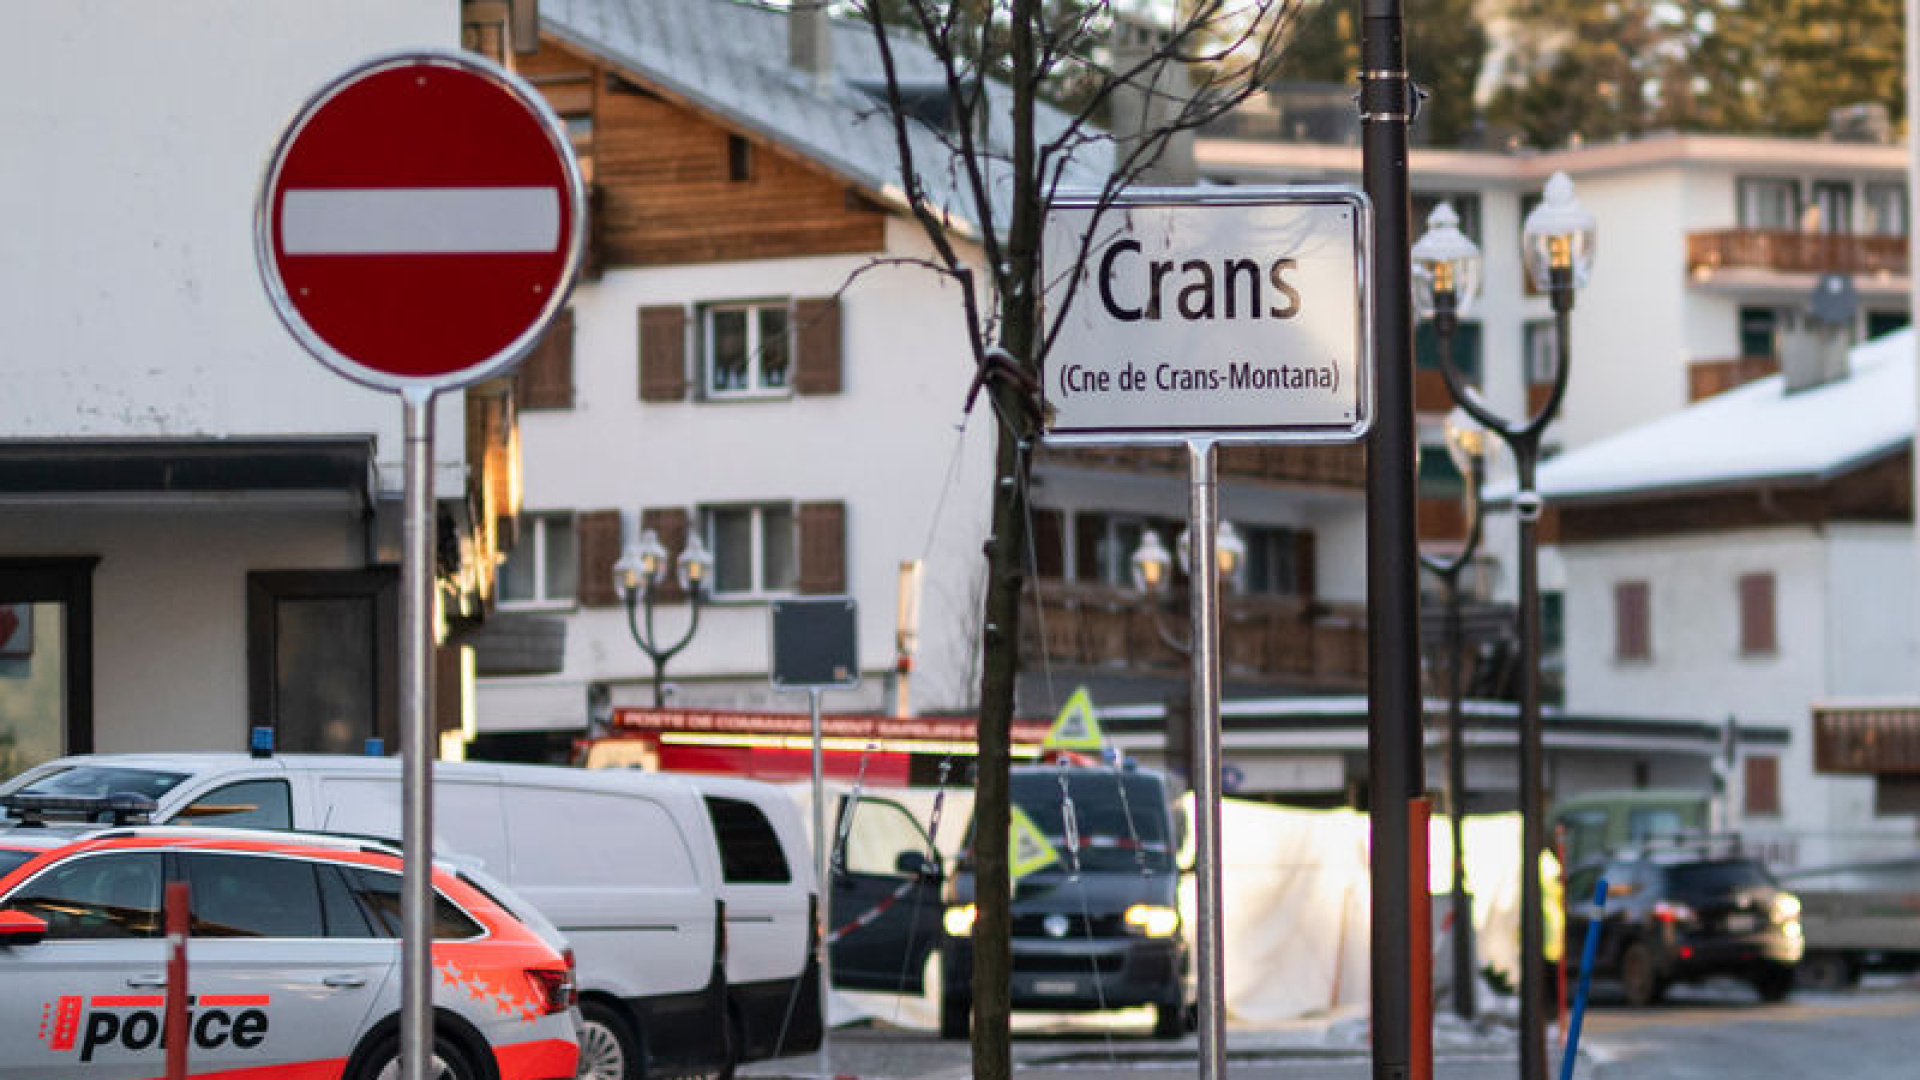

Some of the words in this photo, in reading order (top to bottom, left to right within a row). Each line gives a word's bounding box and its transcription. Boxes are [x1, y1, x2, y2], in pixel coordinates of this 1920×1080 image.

[1098, 239, 1302, 322] Crans
[1060, 363, 1110, 396] (Cne
[1118, 362, 1146, 391] de
[1155, 361, 1340, 391] Crans-Montana)
[79, 996, 269, 1062] poce
